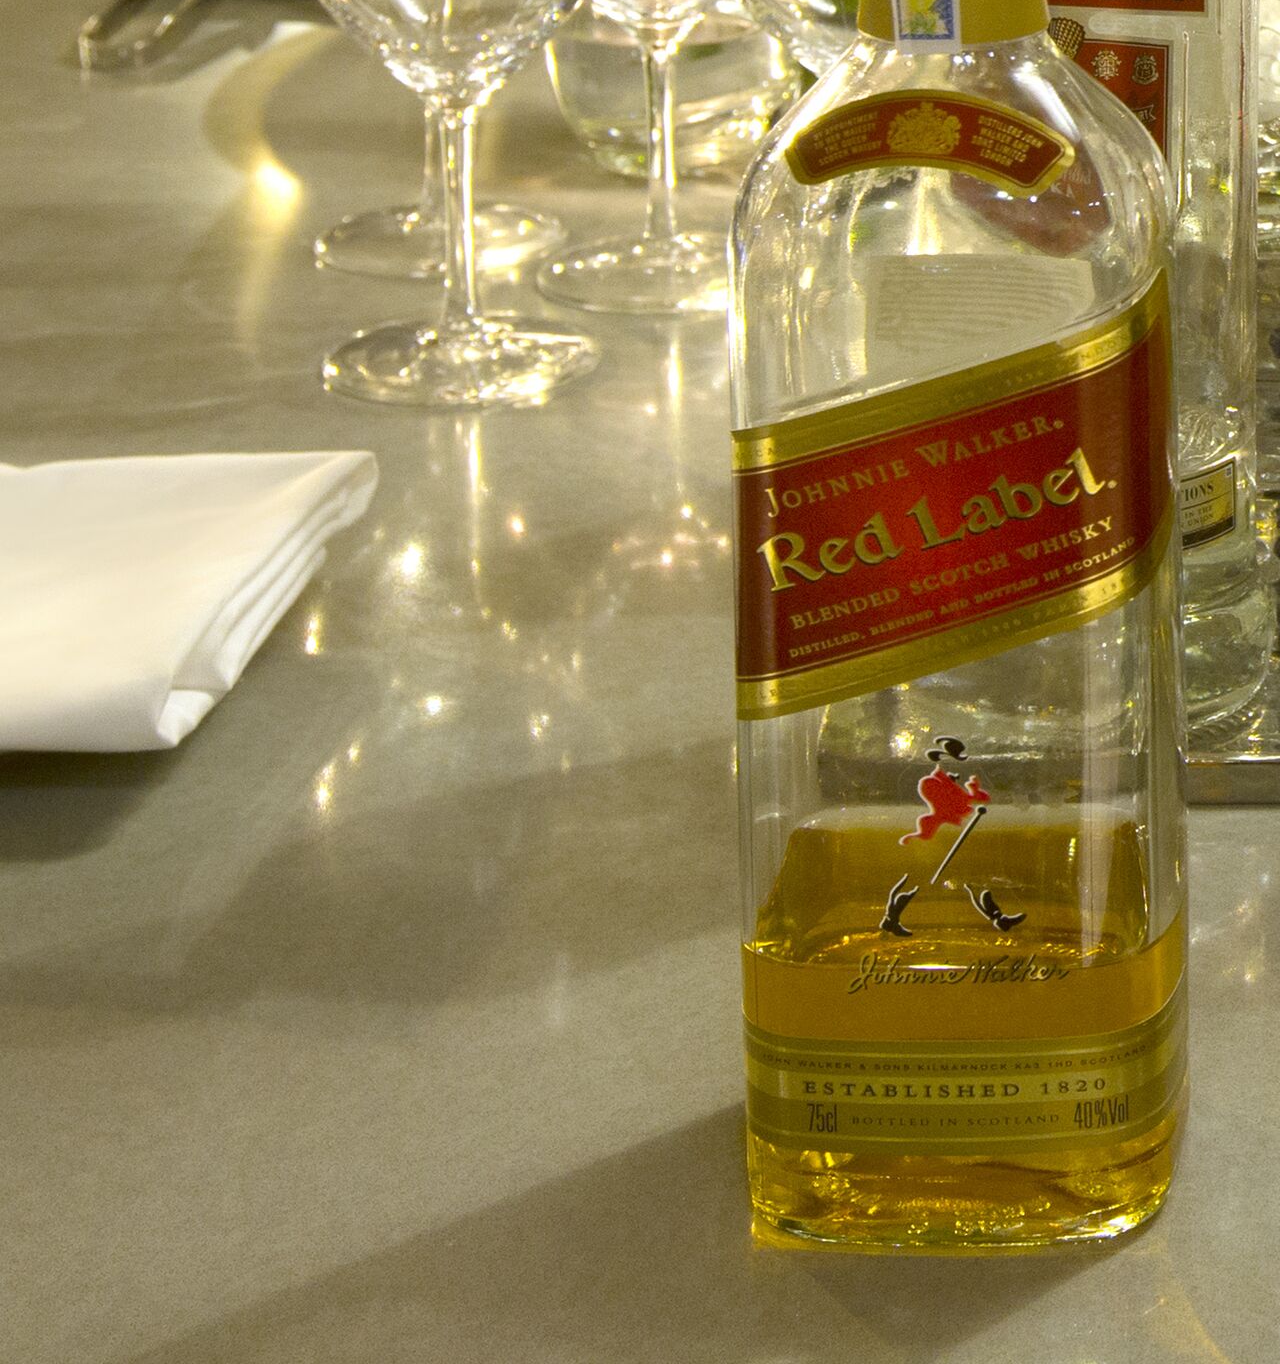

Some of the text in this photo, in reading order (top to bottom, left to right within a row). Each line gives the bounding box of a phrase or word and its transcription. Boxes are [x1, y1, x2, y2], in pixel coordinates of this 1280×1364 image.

[764, 418, 1056, 518] JOHNNIE WALKER
[756, 447, 1102, 593] Red Label
[788, 516, 1114, 630] BLENDED SCOTCH WHISKY
[938, 600, 970, 619] AND
[1042, 569, 1062, 587] IN
[1064, 537, 1137, 574] SCOTLAND
[803, 1078, 1107, 1098] ESTABLISHED 1820
[806, 1102, 838, 1134] 75cl
[939, 1116, 958, 1127] IN
[967, 1113, 1060, 1127] SCOTLAND
